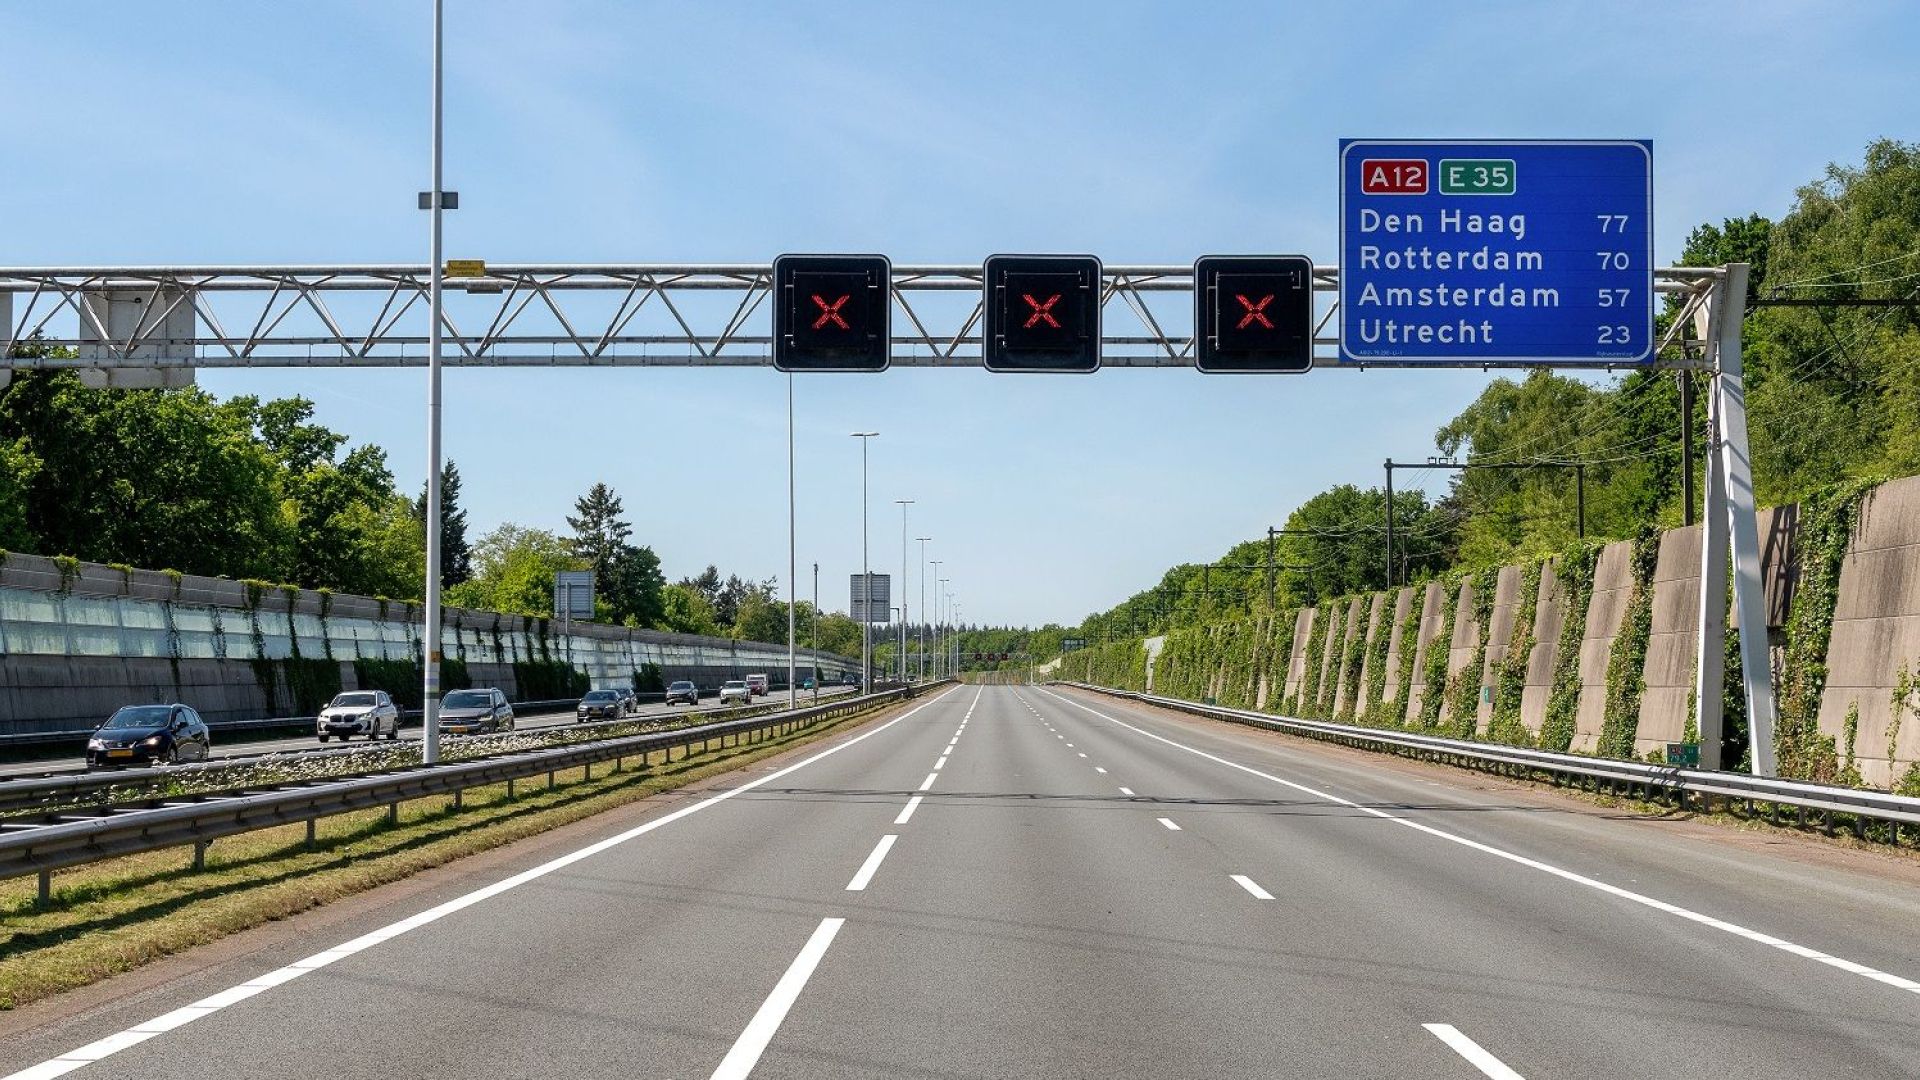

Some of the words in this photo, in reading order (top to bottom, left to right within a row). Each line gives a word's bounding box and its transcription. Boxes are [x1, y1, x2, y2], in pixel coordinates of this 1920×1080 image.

[1369, 166, 1422, 187] A12
[1449, 167, 1465, 187] E
[1473, 167, 1508, 187] 35
[1360, 209, 1423, 233] Den
[1440, 209, 1525, 240] Haag
[1597, 215, 1629, 233] 77
[1360, 246, 1543, 270] Rotterdam
[1597, 252, 1630, 270] 70
[1358, 282, 1559, 307] Amsterdam
[1597, 289, 1630, 307] 57
[1360, 319, 1493, 343] Utrecht
[1597, 325, 1631, 344] 23
